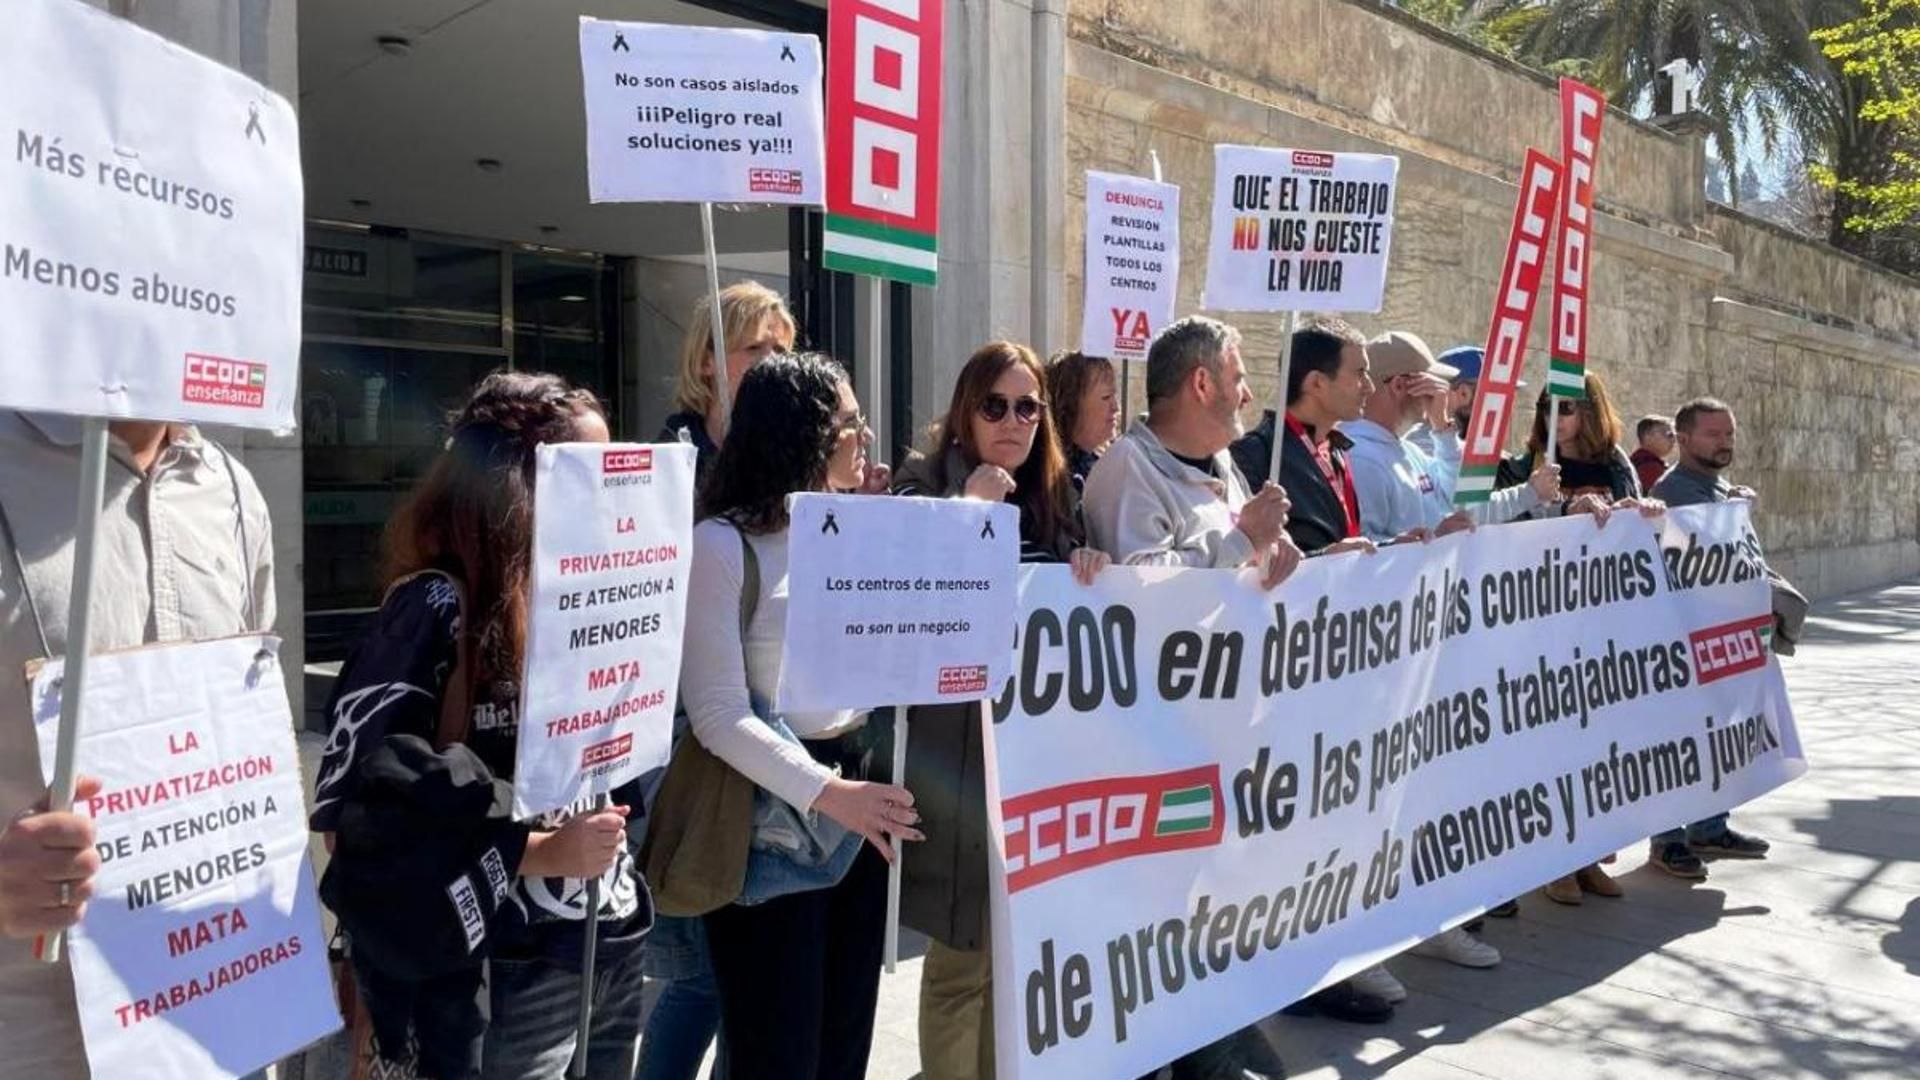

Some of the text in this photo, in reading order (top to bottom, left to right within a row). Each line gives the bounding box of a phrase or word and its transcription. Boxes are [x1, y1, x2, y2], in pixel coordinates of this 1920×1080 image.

[615, 73, 799, 96] No son casos aislados
[744, 110, 782, 128] real
[628, 135, 793, 155] soluciones ya!!!
[1294, 152, 1321, 164] CCOO
[17, 129, 235, 220] Más recursos
[752, 171, 790, 182] CCOO
[1105, 190, 1164, 211] DENUNCIA
[1232, 174, 1389, 219] QUE EL TRABAJO
[1104, 234, 1165, 252] PLANTILLAS
[1232, 217, 1383, 254] NO NOS CUESTE
[1106, 255, 1162, 273] TODOS LOS
[1267, 259, 1342, 292] LA VIDA
[4, 244, 236, 317] Menos abusos
[1110, 276, 1157, 292] CENTROS
[1112, 307, 1150, 339] YA
[186, 356, 249, 386] CCOO
[186, 384, 262, 405] enseñanza
[605, 455, 640, 469] CCOO
[616, 517, 636, 533] LA
[558, 577, 675, 611] DE ATENCIÓN A
[826, 576, 990, 591] Los centros de menores
[568, 613, 661, 650] MENORES
[845, 618, 971, 635] no son un negocio
[1157, 625, 1244, 703] en
[1260, 595, 1401, 696] defensa
[1409, 573, 1437, 656] de
[1439, 567, 1471, 640] las
[1480, 543, 1656, 629] condiciones
[588, 661, 641, 691] MATA
[941, 668, 978, 681] CCOO
[546, 689, 665, 738] TRABAJADORAS
[169, 731, 199, 755] LA
[1233, 747, 1298, 838] de
[1310, 731, 1362, 819] las
[1369, 686, 1491, 812] personas
[1497, 640, 1691, 736] trabajadoras
[1695, 629, 1760, 673] CCOO
[585, 741, 621, 764] CCOO
[88, 755, 274, 819] PRIVATIZACIÓN
[95, 795, 278, 863] DE ATENCIÓN A
[126, 843, 267, 911] MENORES
[1025, 937, 1092, 1056] de
[1106, 847, 1358, 1043] protección
[1363, 828, 1402, 912] de
[1410, 782, 1553, 882] menores
[1556, 772, 1576, 845] y
[1581, 736, 1701, 821] reforma
[167, 908, 249, 958] MATA
[114, 936, 303, 1029] TRABAJADORAS
